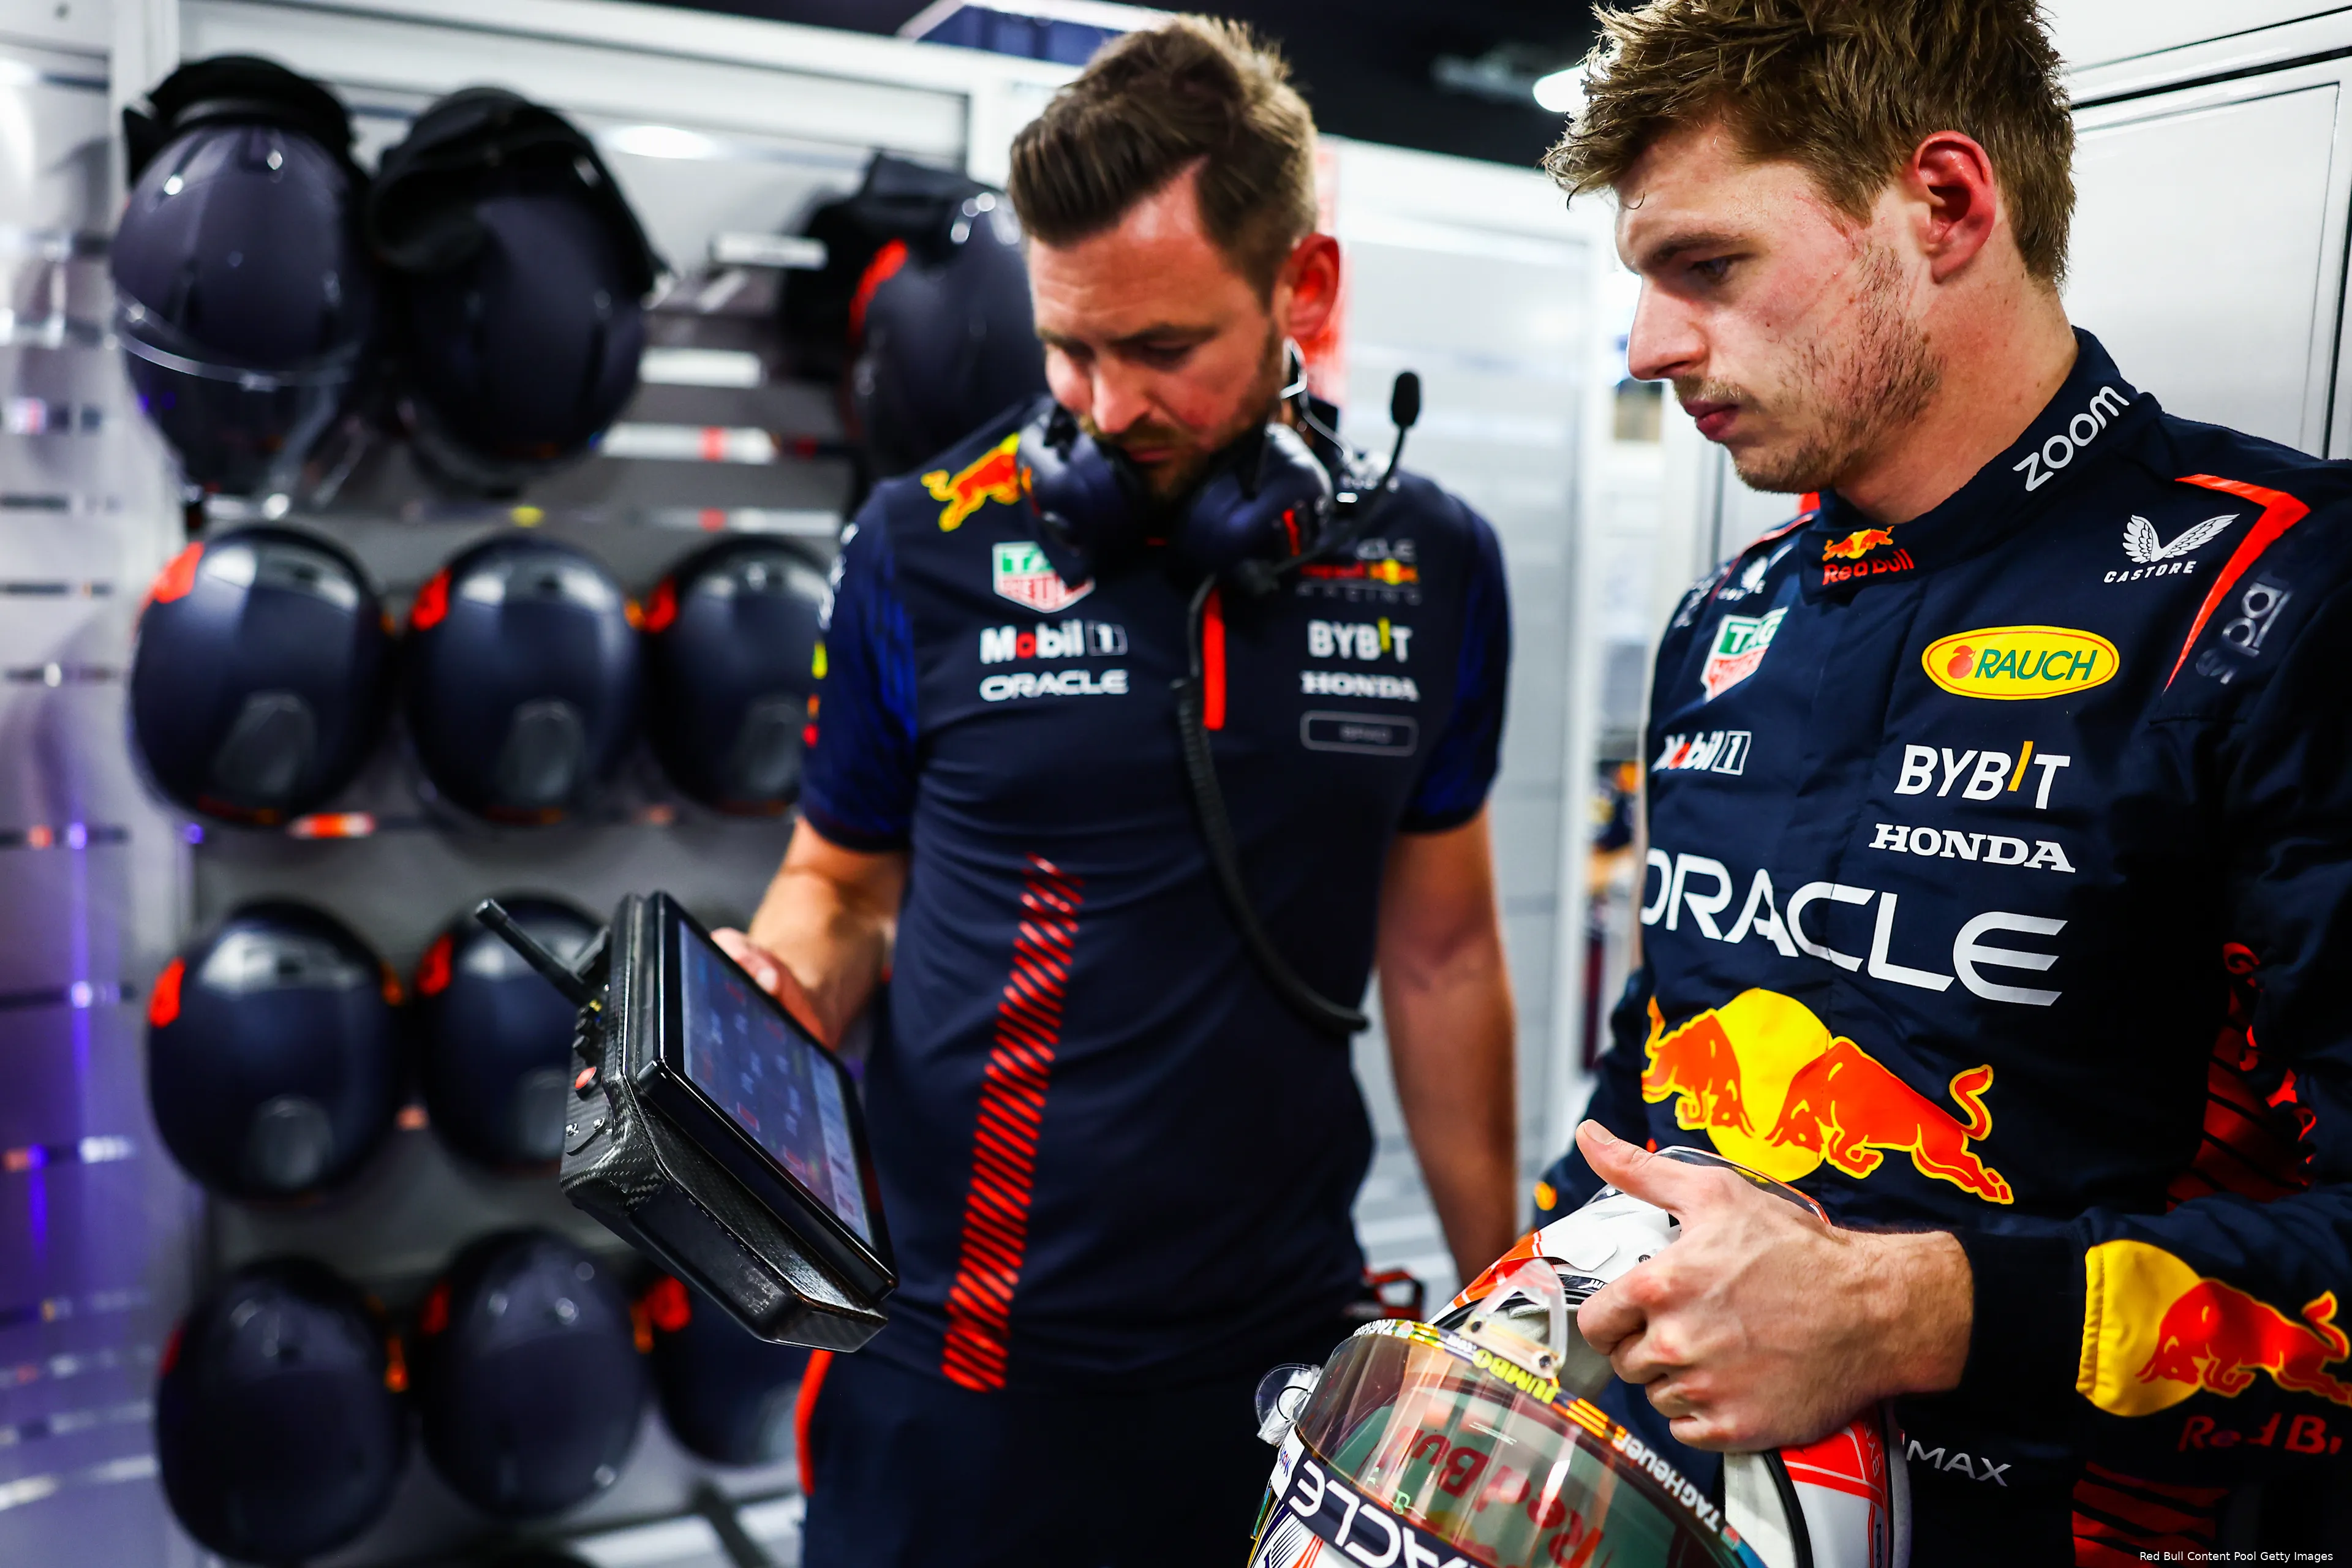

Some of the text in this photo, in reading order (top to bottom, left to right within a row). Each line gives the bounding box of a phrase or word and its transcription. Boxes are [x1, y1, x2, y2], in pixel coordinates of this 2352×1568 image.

[2012, 386, 2130, 491] zoom
[2103, 560, 2197, 583] CASTORE
[980, 619, 1085, 665] Mobil
[1307, 617, 1413, 663] BYBIT
[979, 668, 1129, 702] ORACLE
[1300, 670, 1420, 702] HONDA
[1974, 648, 2098, 681] RAUCH
[1893, 740, 2071, 810] BYBIT
[1868, 823, 2076, 873] HONDA
[1907, 1439, 2012, 1487] MAX
[1288, 1460, 1476, 1568] ACLE
